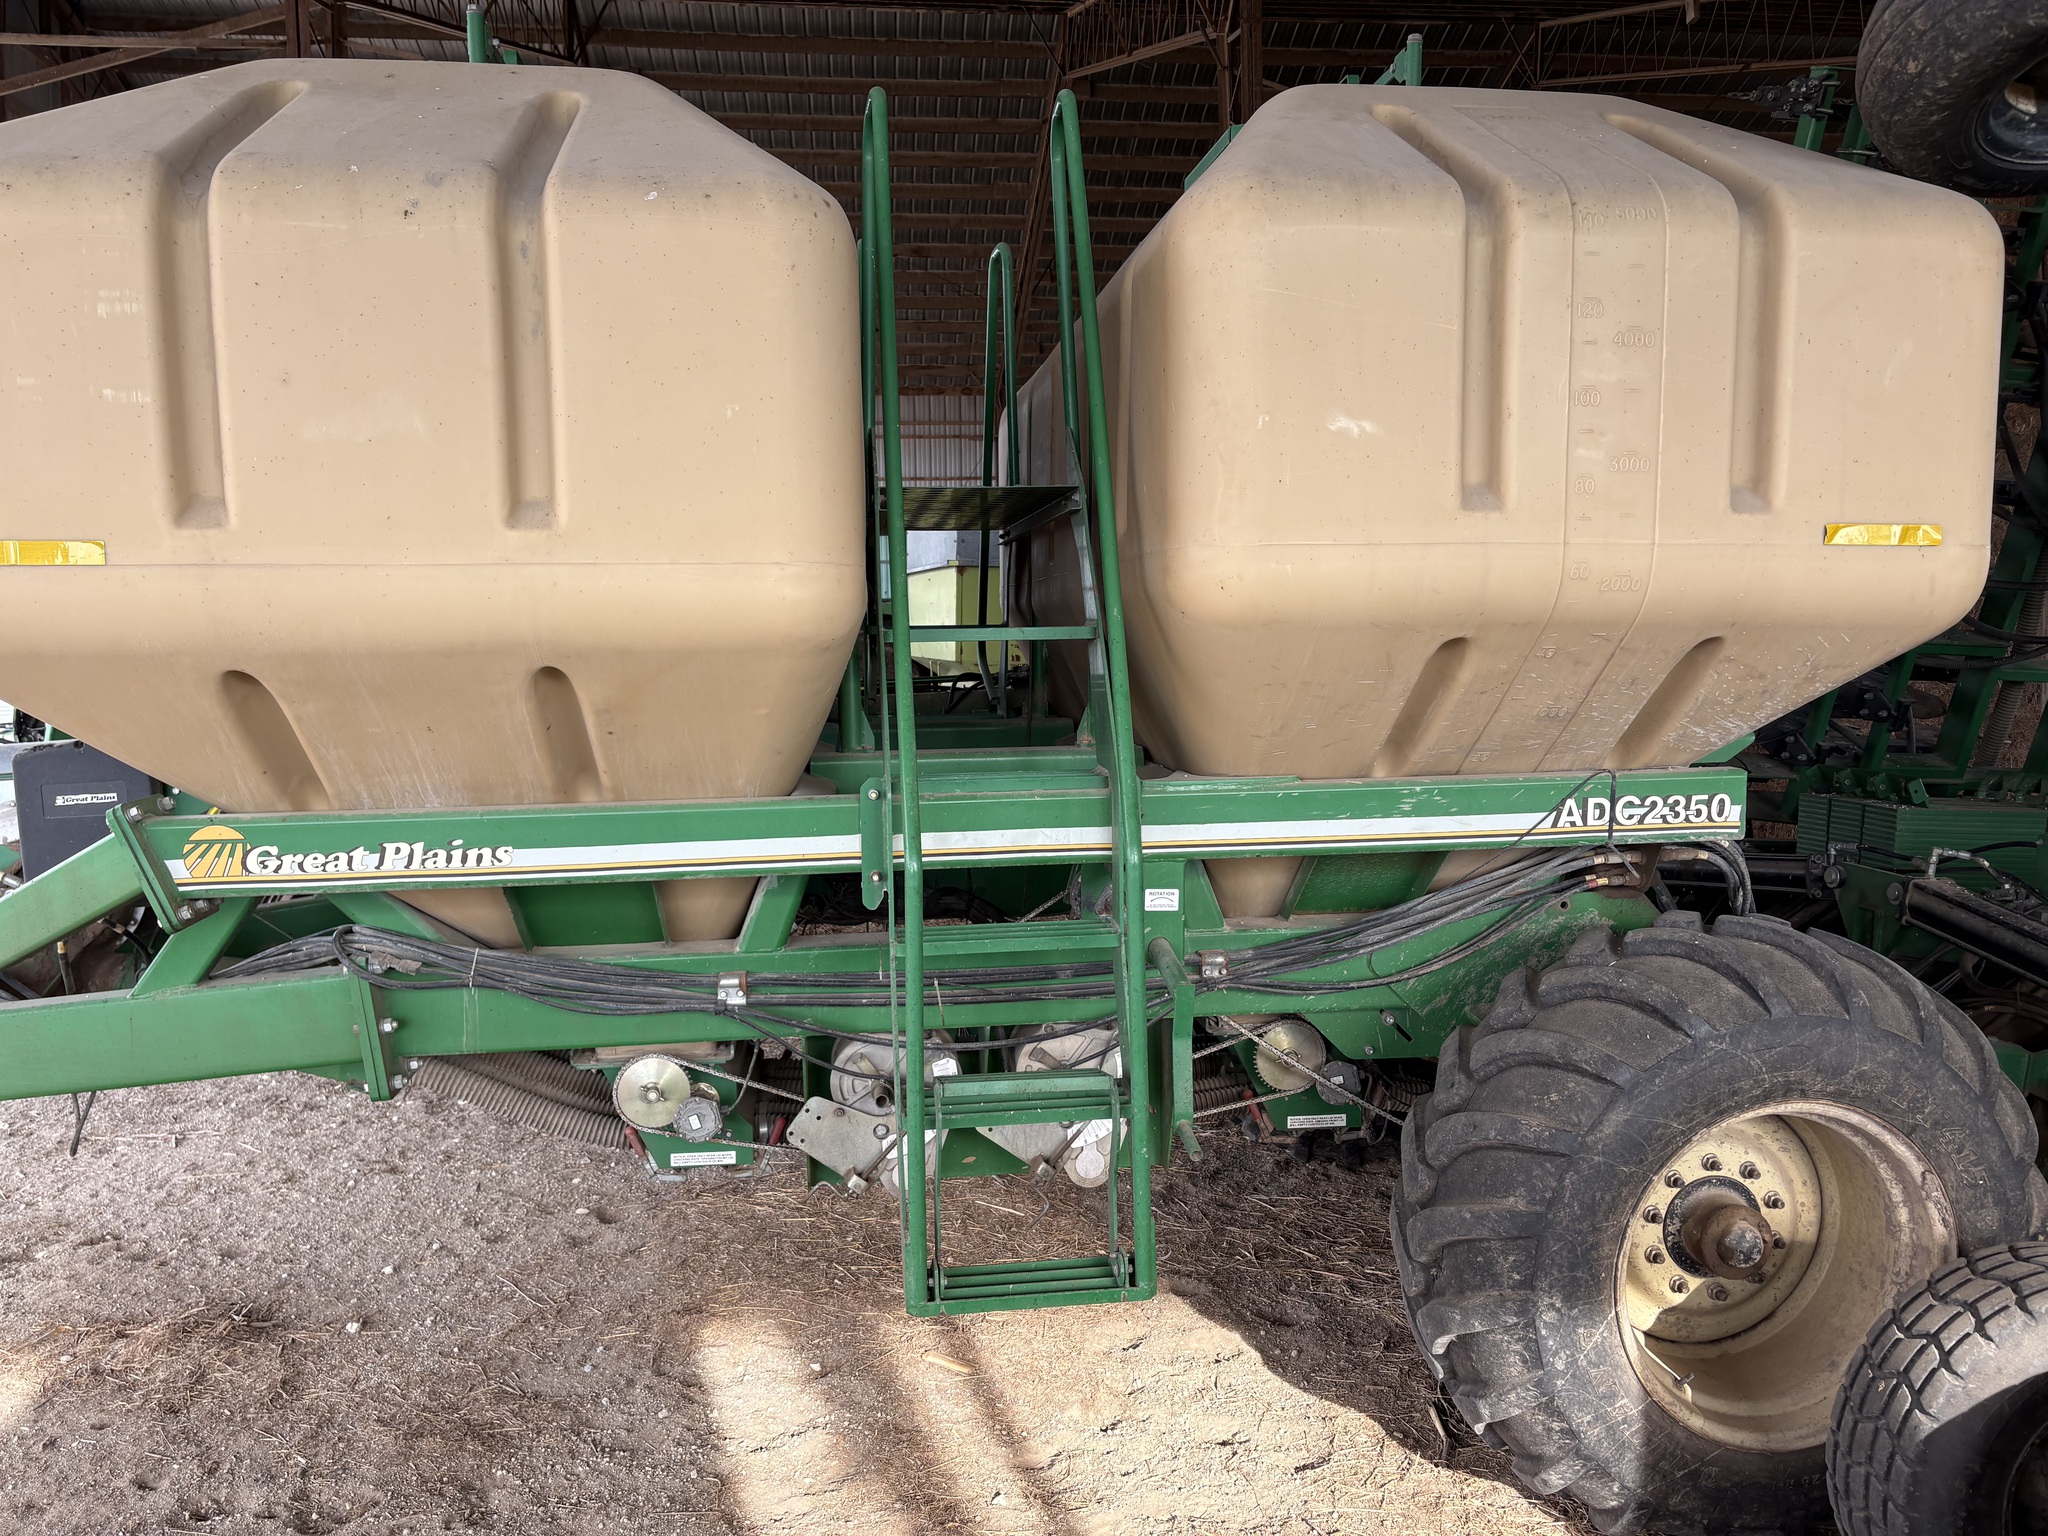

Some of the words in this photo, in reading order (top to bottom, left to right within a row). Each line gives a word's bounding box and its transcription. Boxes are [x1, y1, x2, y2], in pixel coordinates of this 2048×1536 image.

[1577, 212, 1605, 228] 140
[1615, 206, 1657, 221] 5000
[1577, 302, 1604, 318] 120
[1613, 331, 1656, 348] 4000
[1573, 390, 1601, 407] 100
[1609, 456, 1650, 473] 3000
[1574, 478, 1595, 494] 80
[1570, 564, 1590, 580] 60
[1599, 576, 1642, 592] 2000
[1553, 793, 1732, 828] ADC2350
[242, 845, 370, 875] Great
[375, 839, 514, 870] Plains
